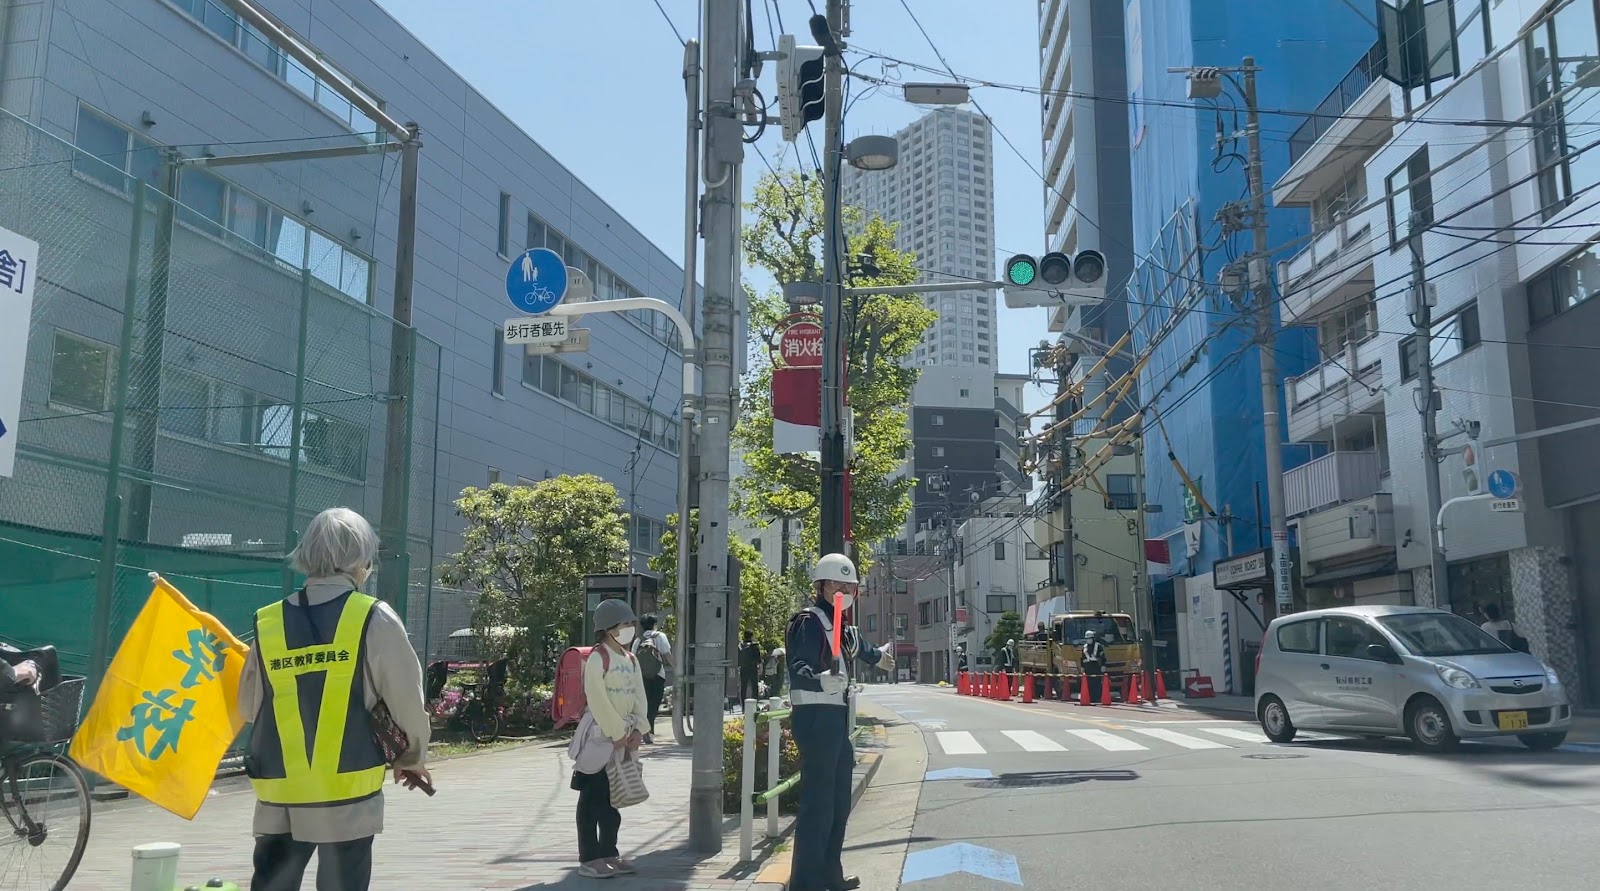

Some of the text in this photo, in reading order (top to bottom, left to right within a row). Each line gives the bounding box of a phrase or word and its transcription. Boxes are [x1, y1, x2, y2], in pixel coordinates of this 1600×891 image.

[506, 321, 564, 339] 歩行者優先
[784, 338, 822, 357] 消火栓
[270, 650, 349, 671] 港区教育委員会
